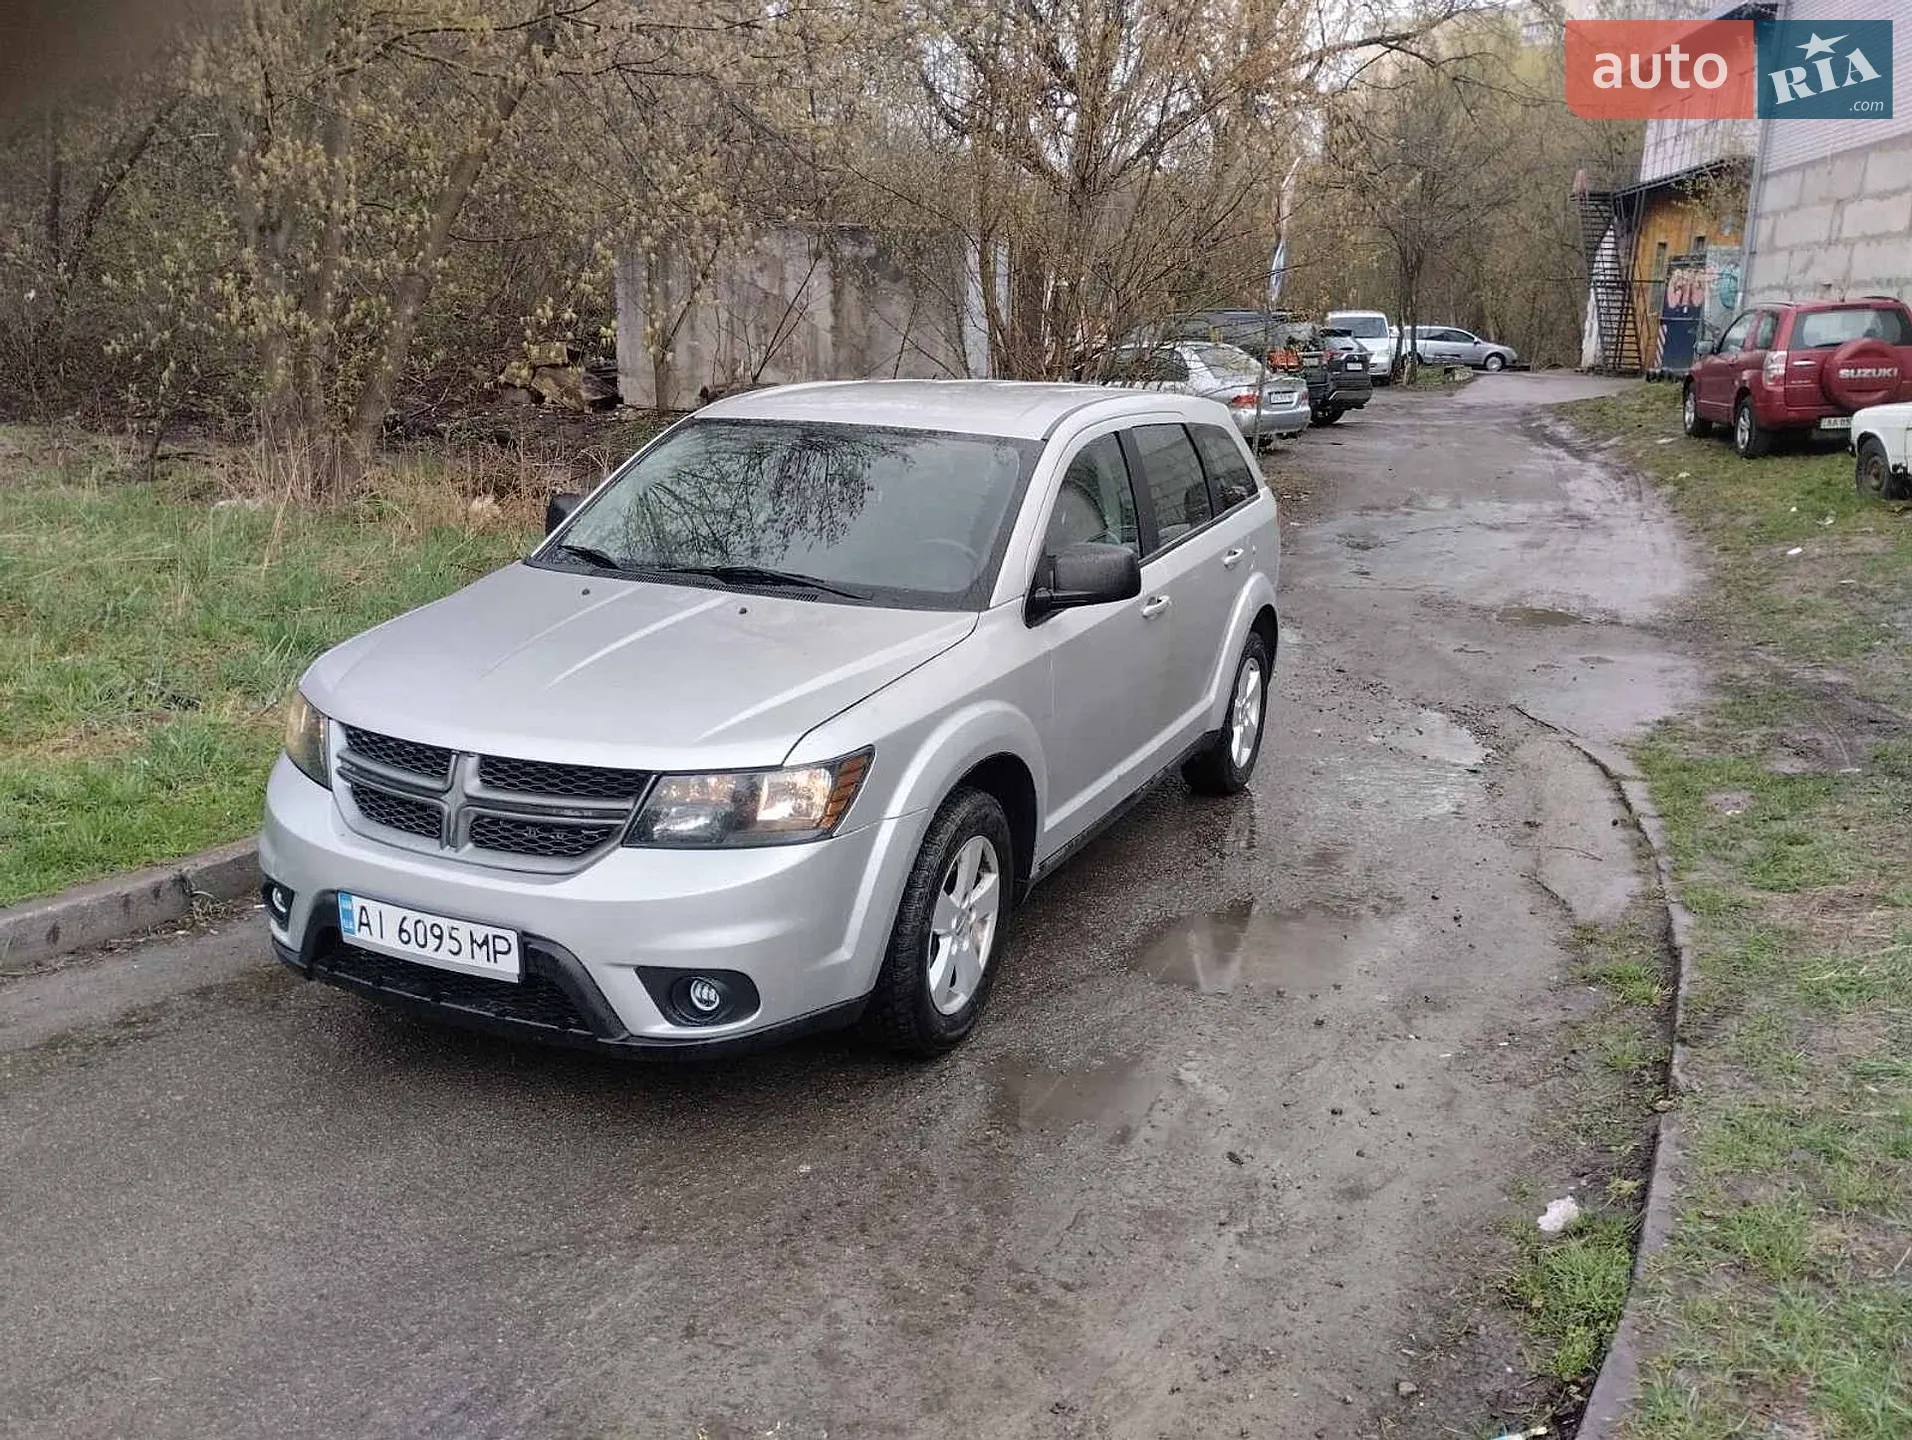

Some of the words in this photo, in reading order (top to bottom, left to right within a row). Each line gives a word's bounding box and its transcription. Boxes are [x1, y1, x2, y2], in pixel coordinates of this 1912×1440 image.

[1838, 367, 1899, 379] SUZUKI
[357, 905, 384, 940] AI
[398, 915, 463, 956] 6095
[469, 930, 512, 963] MP
